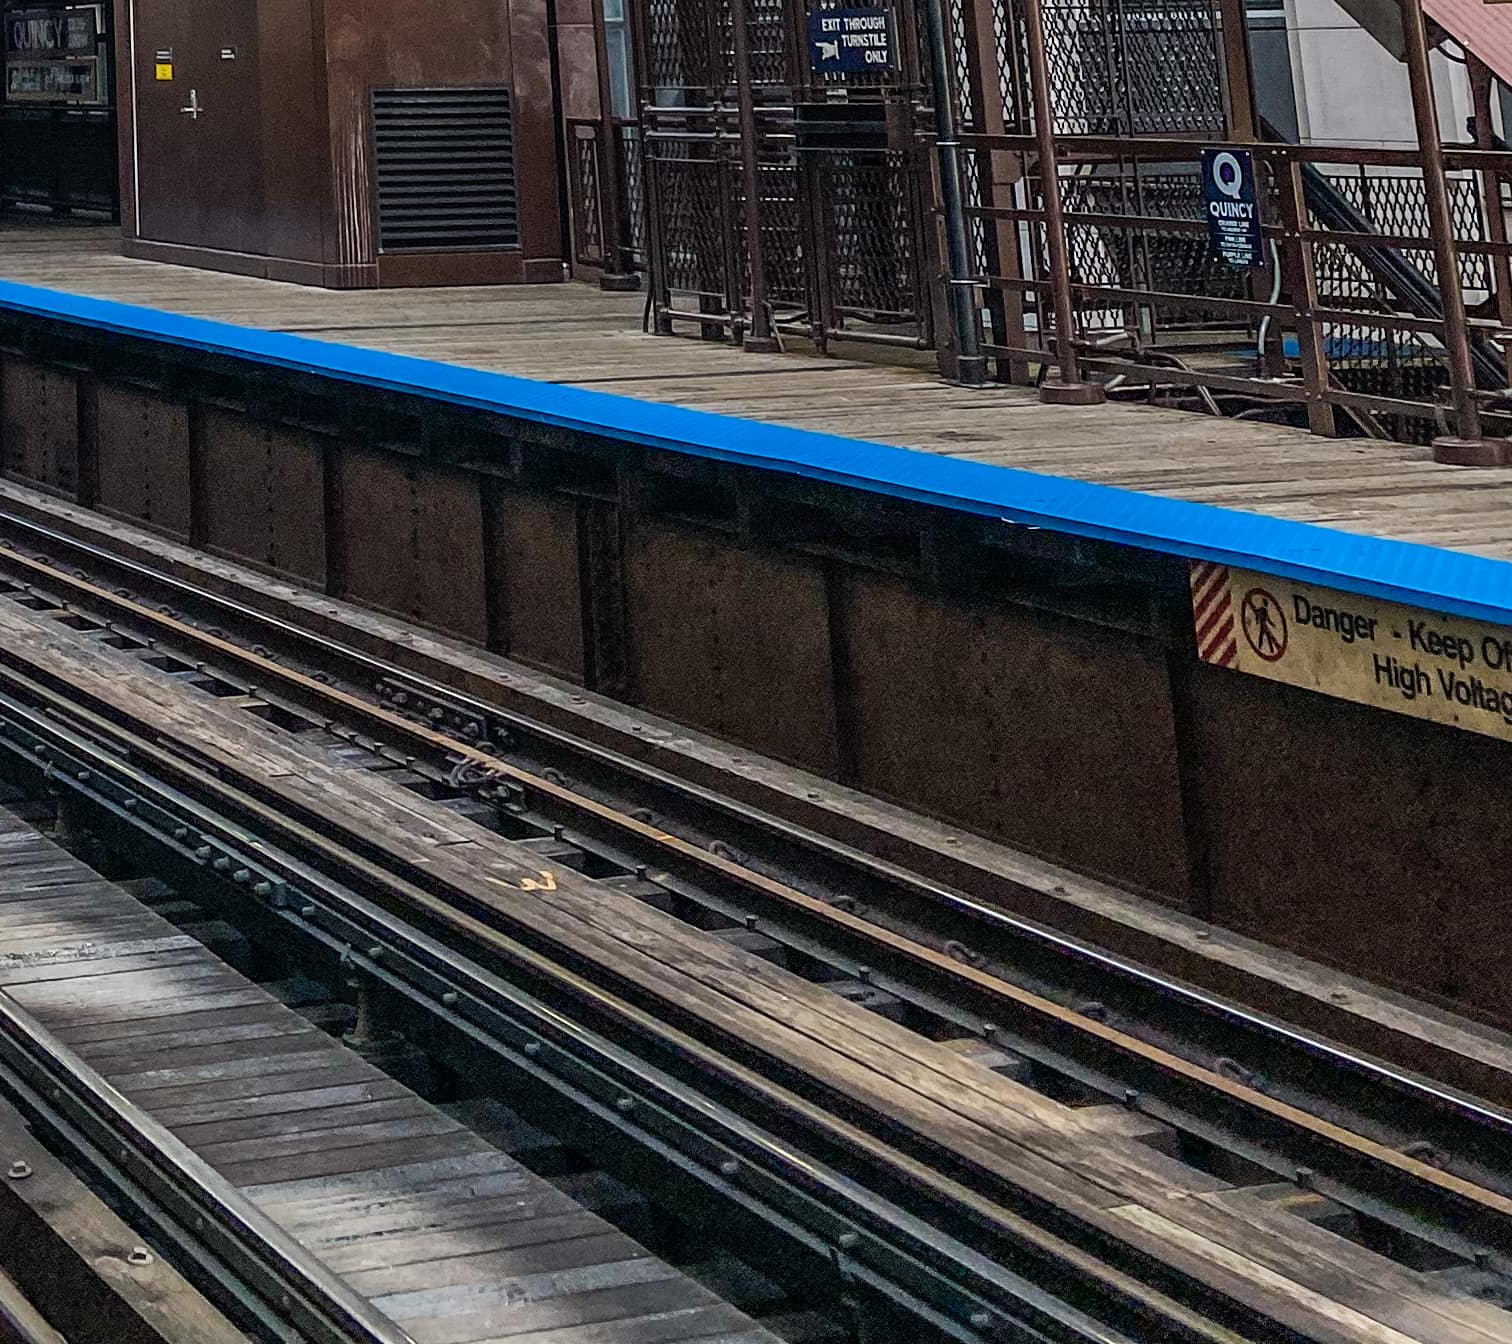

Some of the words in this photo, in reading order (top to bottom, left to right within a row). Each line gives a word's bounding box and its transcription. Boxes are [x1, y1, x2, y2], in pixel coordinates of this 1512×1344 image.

[14, 18, 63, 49] QUINCY
[822, 18, 841, 32] EXIT
[843, 16, 886, 31] THROUGH
[841, 33, 887, 48] TURNSTILE
[865, 50, 888, 64] ONLY
[1213, 152, 1242, 199] Q
[1210, 201, 1254, 219] QUINCY
[1293, 594, 1377, 644] Danger
[1408, 619, 1475, 670] Keep
[1373, 653, 1433, 700] High
